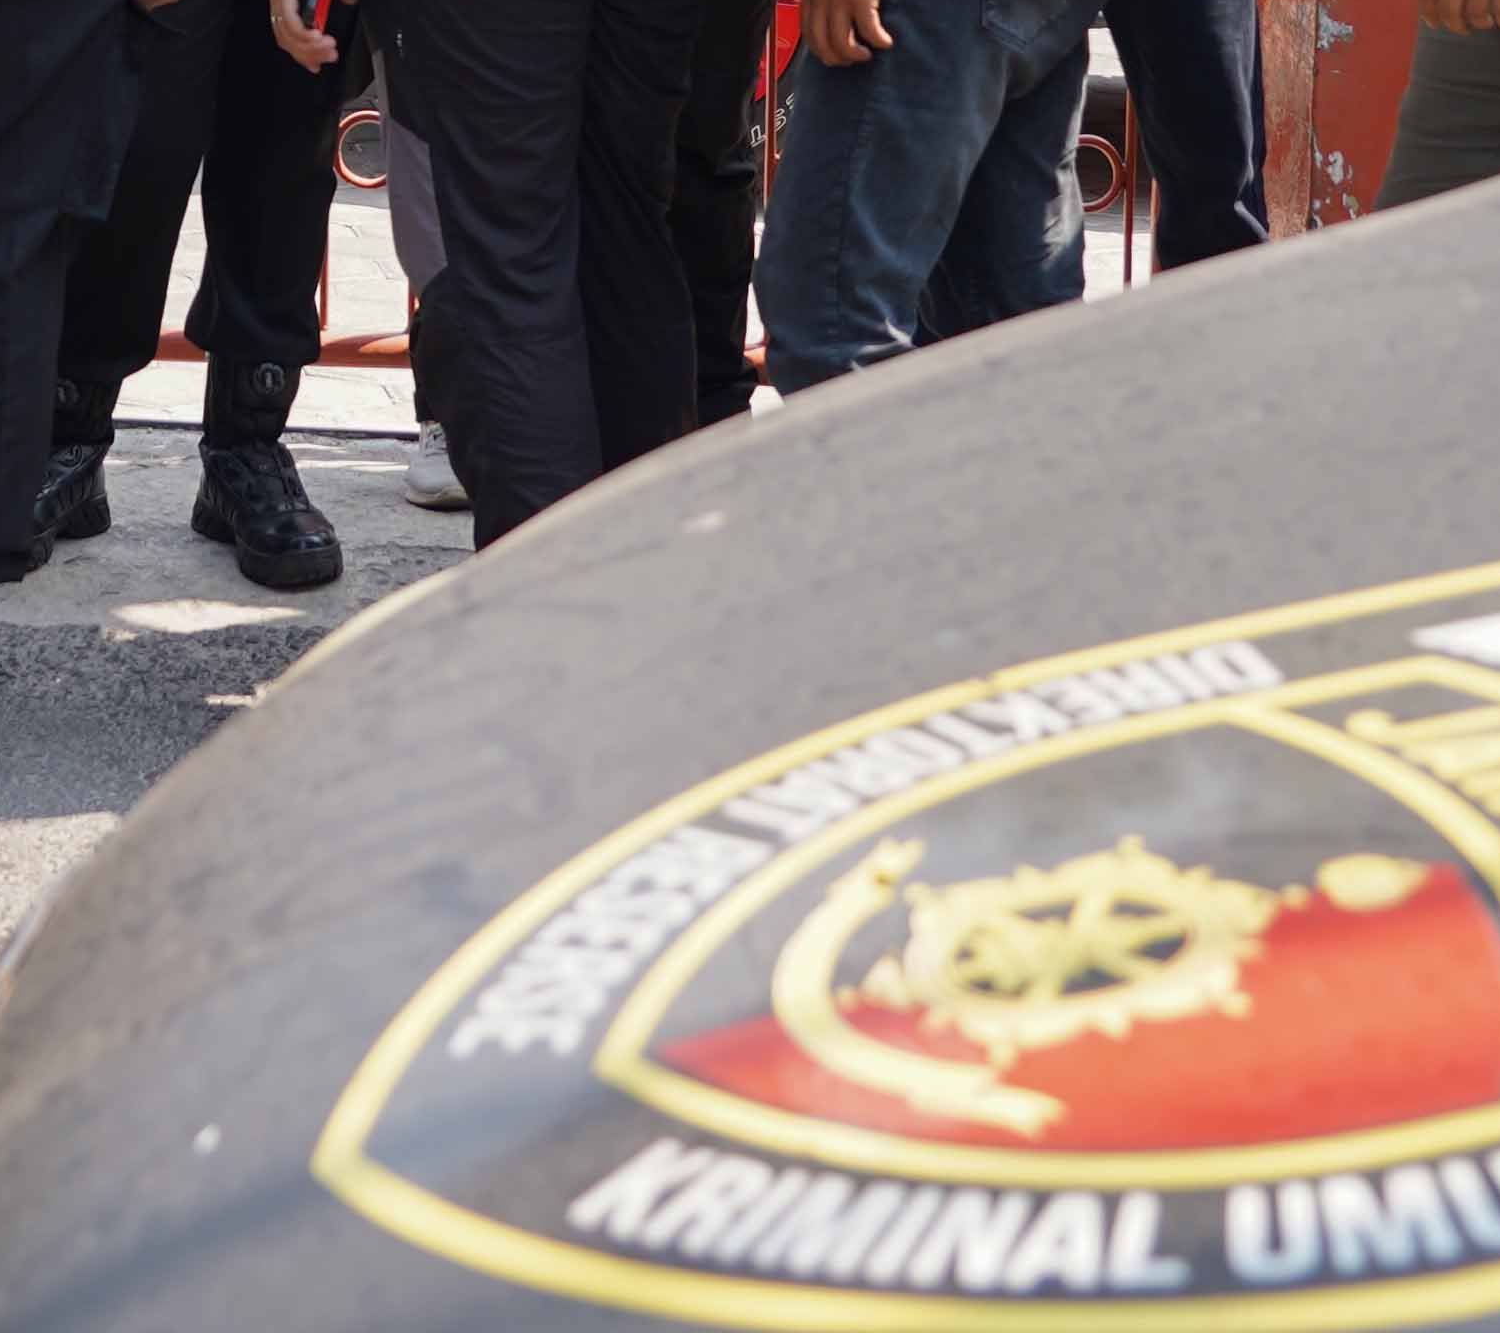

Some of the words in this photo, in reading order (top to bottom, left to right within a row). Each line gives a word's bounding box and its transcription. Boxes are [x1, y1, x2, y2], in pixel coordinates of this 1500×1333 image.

[724, 638, 1286, 846] DIREKTORAT
[447, 823, 777, 1060] RESERSE
[563, 1136, 1192, 1293] KRIMINAL
